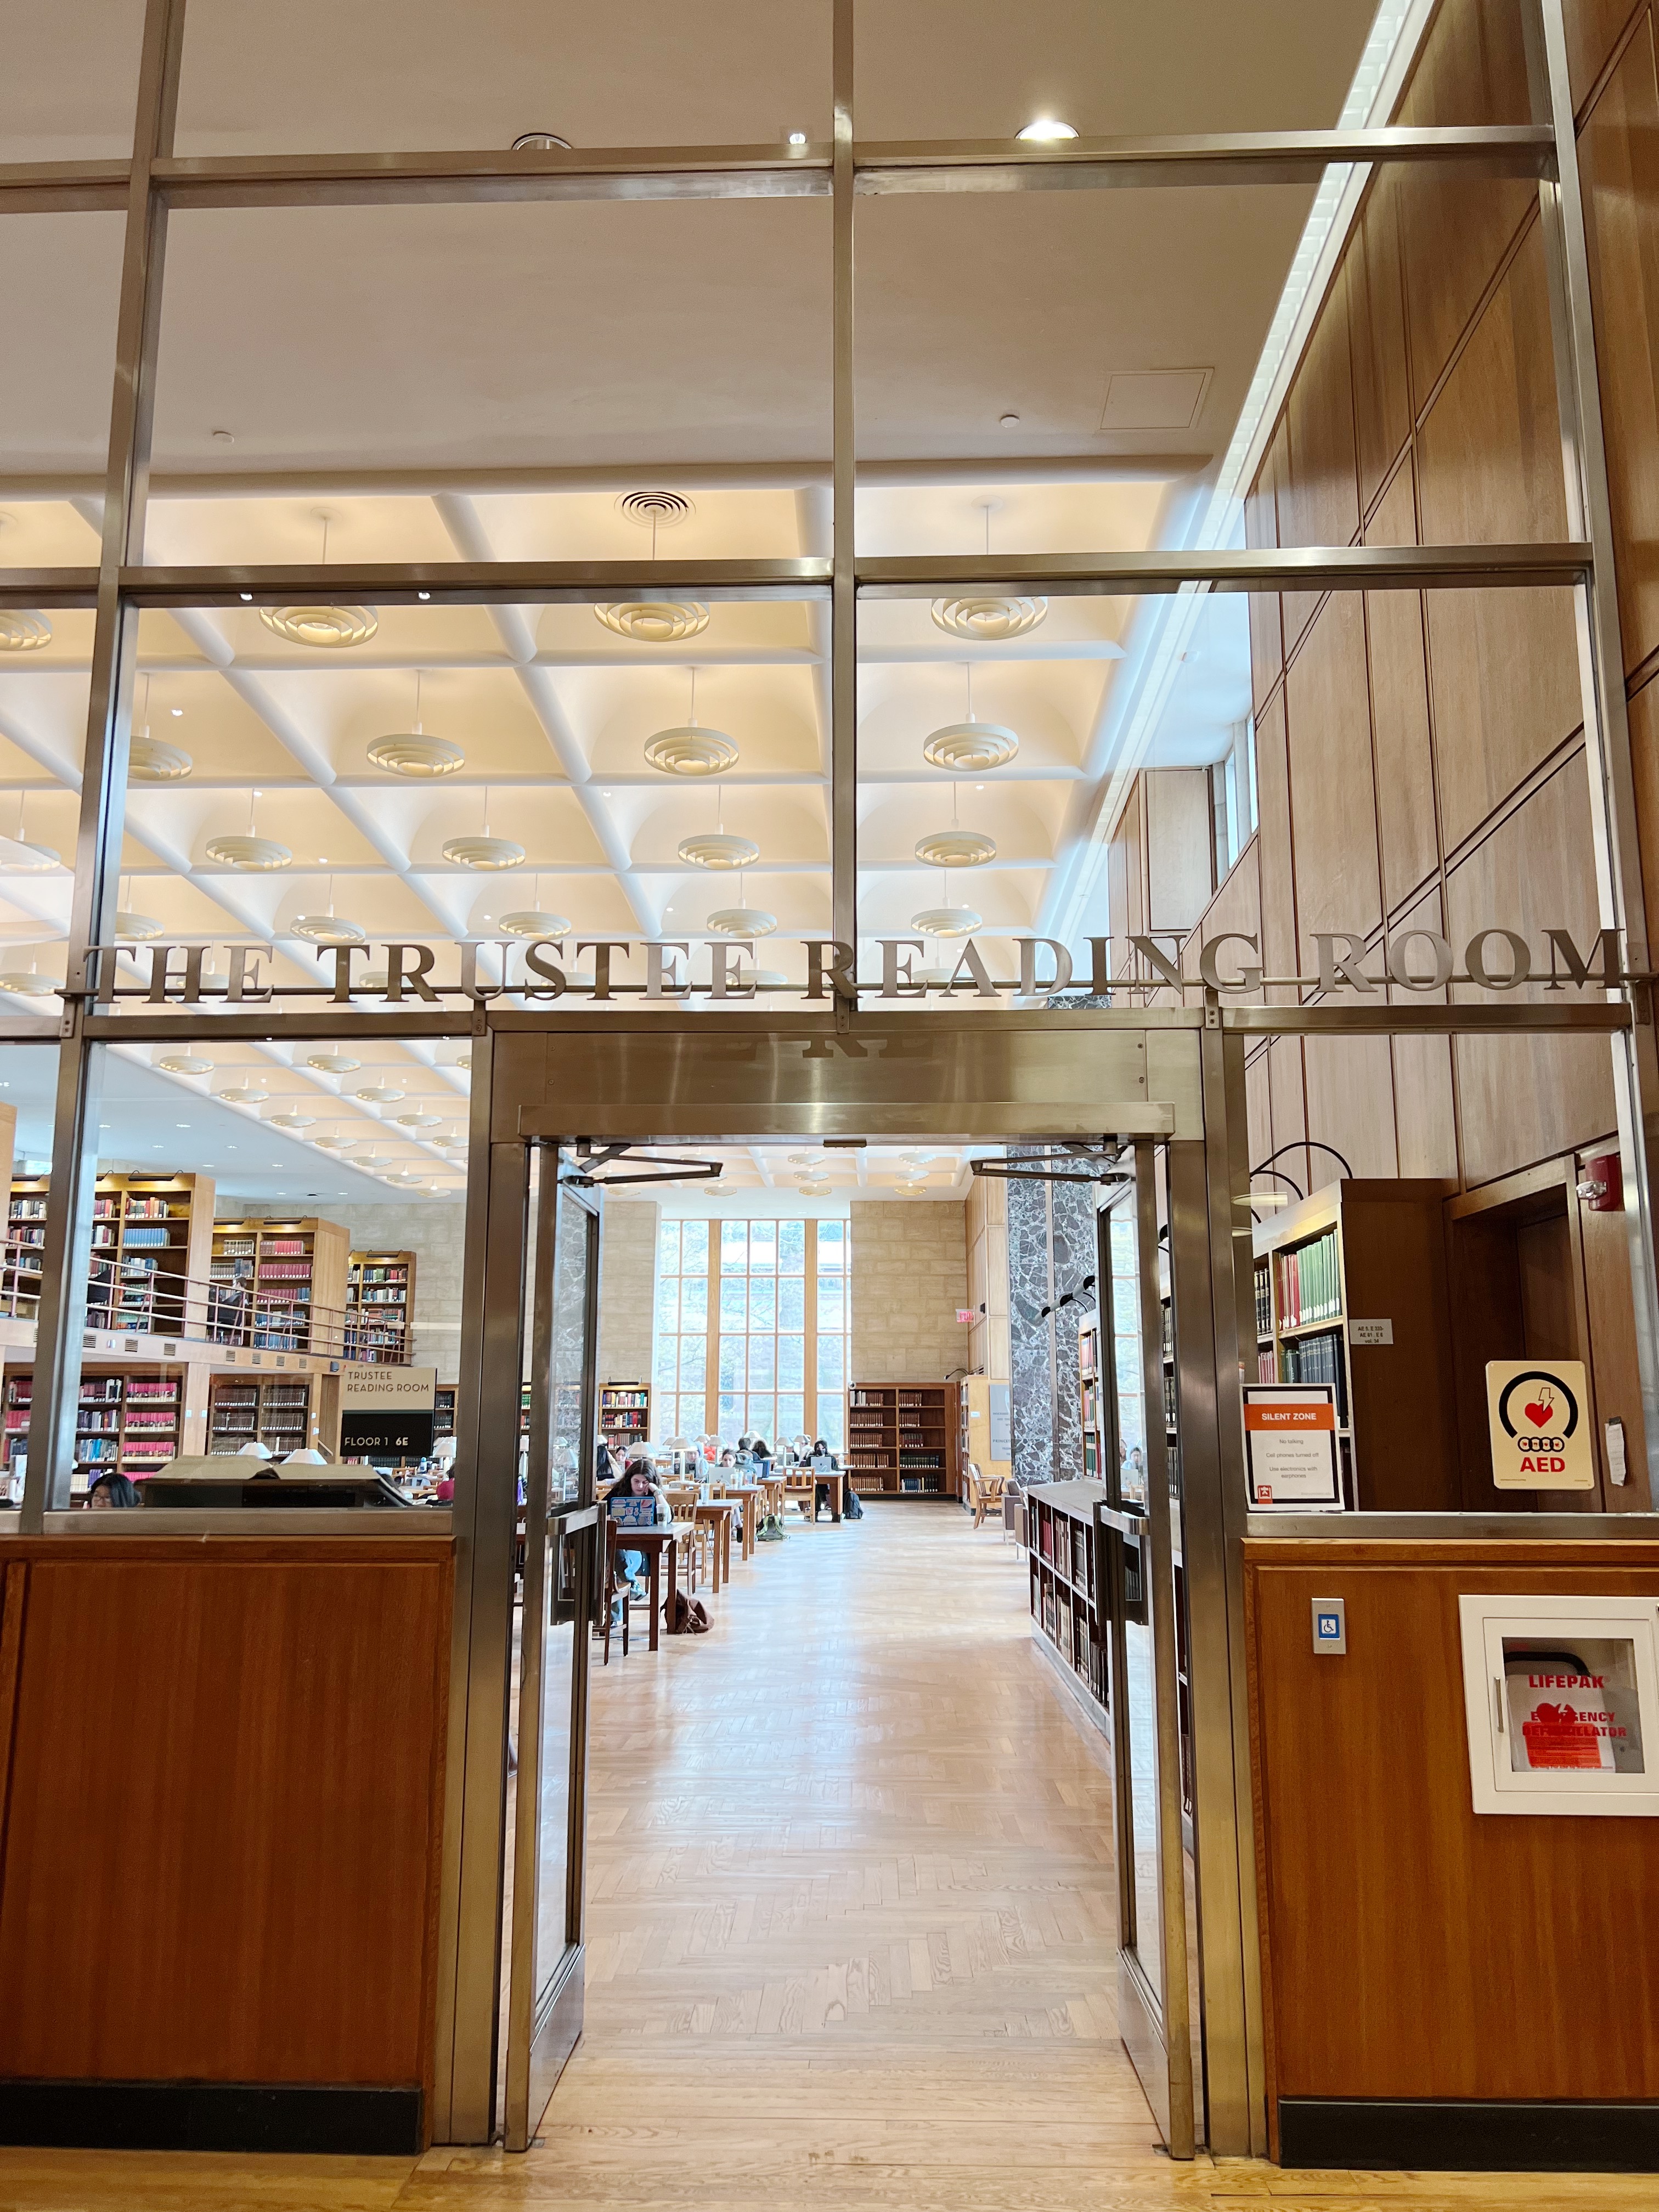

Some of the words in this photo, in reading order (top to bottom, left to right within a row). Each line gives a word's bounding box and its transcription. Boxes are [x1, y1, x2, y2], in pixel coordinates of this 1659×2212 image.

[83, 944, 274, 1003] THE
[317, 940, 757, 1003] TRUSTEE
[800, 932, 1265, 1001] READING
[1310, 928, 1627, 993] ROOM
[348, 1372, 392, 1380] TRUSTEE
[347, 1384, 394, 1392] READING
[397, 1384, 429, 1392] ROOM
[345, 1437, 380, 1446] FLOOR
[384, 1437, 388, 1446] 1
[396, 1437, 409, 1446] 6E
[1520, 1457, 1565, 1472] AED
